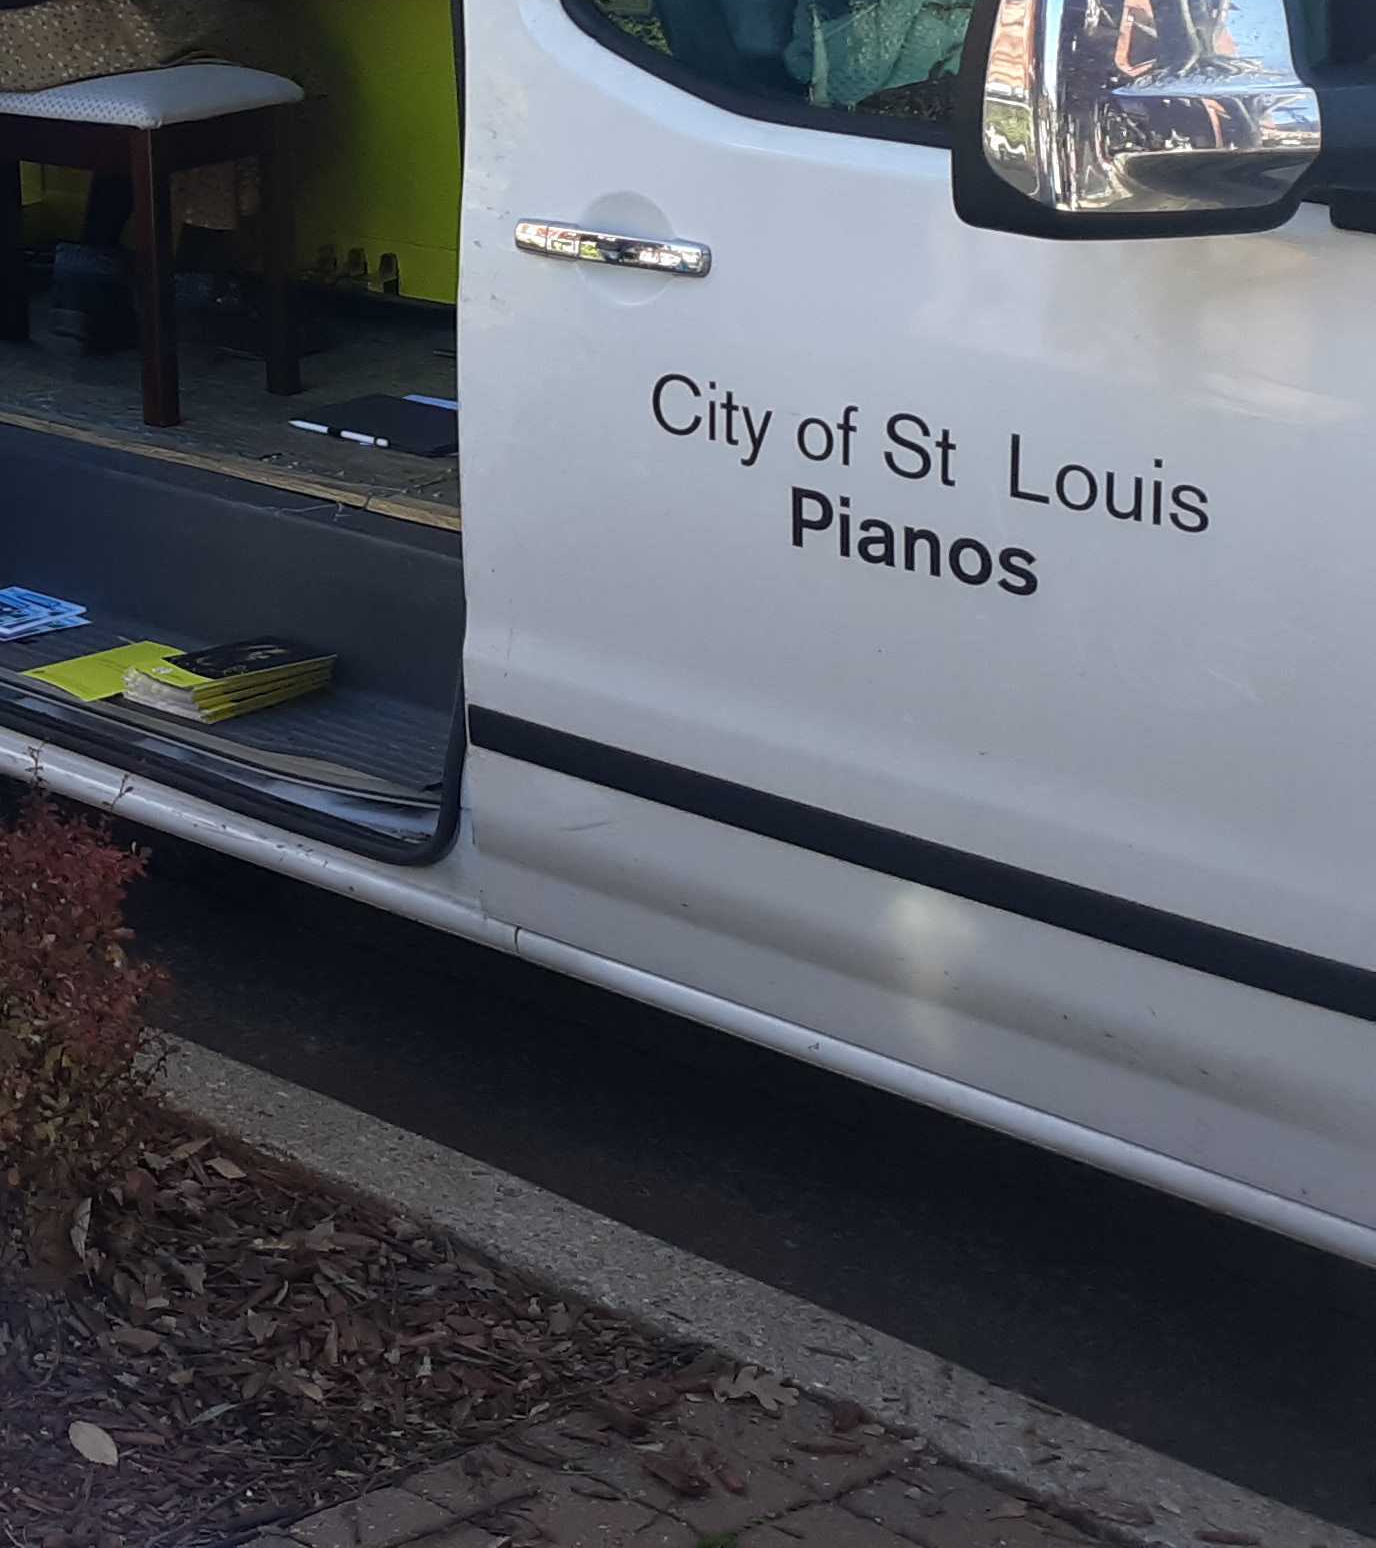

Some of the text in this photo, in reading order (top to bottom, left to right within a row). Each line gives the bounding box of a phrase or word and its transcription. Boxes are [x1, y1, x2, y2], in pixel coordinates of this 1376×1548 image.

[650, 372, 1210, 534] City of St Louis
[790, 485, 1039, 597] Pianos
